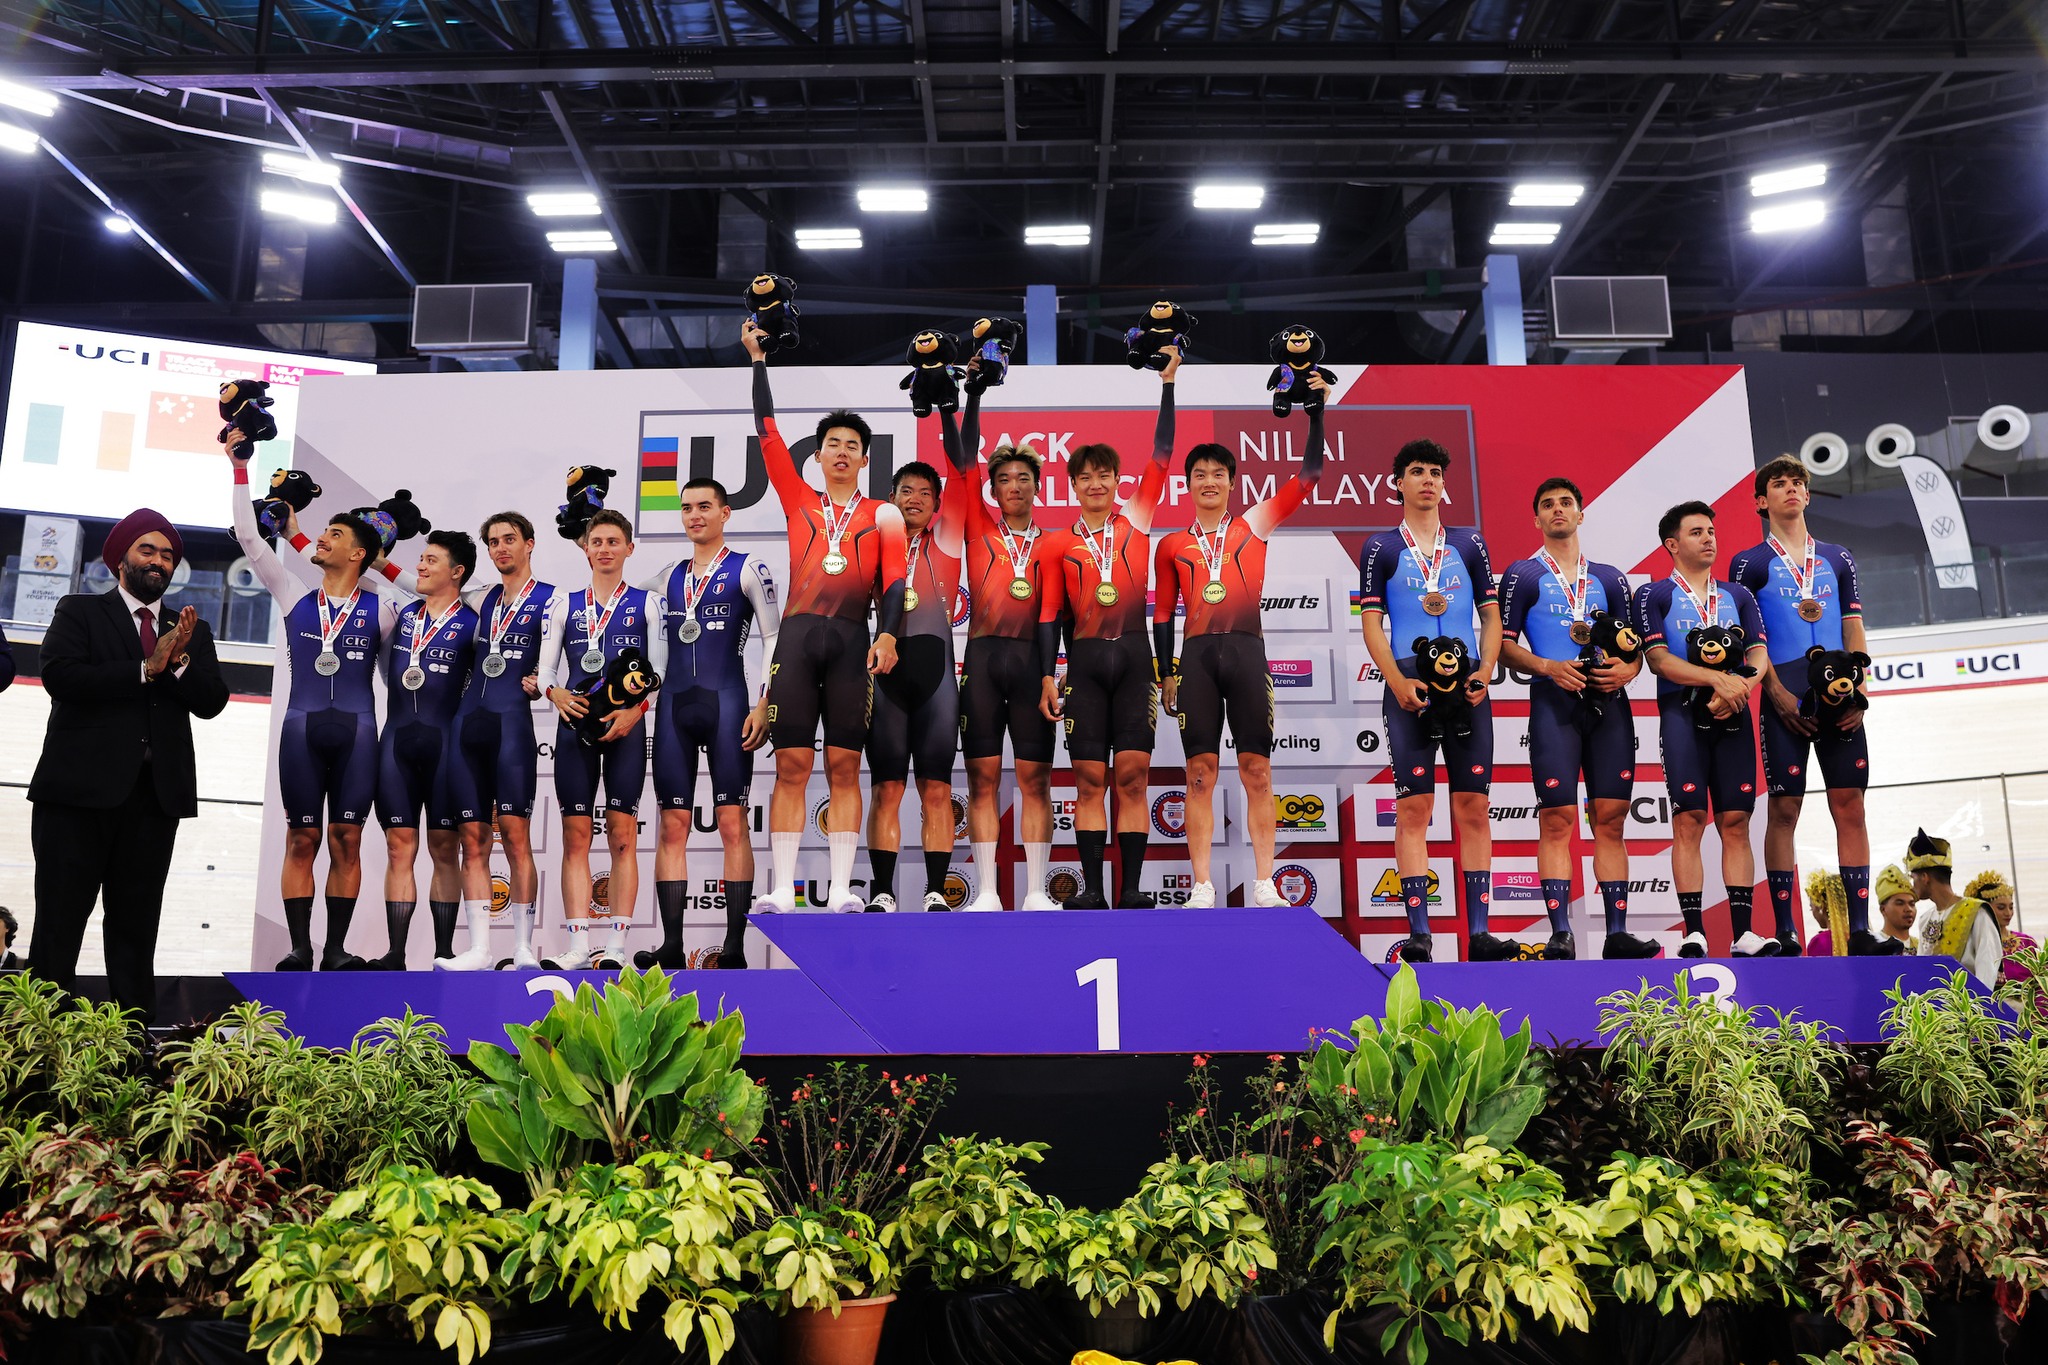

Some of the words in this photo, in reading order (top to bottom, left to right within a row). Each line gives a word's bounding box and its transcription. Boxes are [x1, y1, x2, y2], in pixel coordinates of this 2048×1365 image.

[75, 343, 150, 366] UCI
[939, 431, 1075, 463] RACK
[1241, 474, 1452, 505] MLAYSA
[1366, 541, 1382, 593] CASTELLI
[758, 563, 776, 600] CIC
[1406, 575, 1461, 589] ITAIA
[1779, 584, 1832, 598] ITAIA
[1259, 595, 1319, 612] sports
[1502, 573, 1520, 626] CASTELLI
[705, 605, 728, 616] CIC
[1549, 603, 1599, 615] ITAIA
[1640, 587, 1652, 633] CASTELLI
[1676, 619, 1734, 630] ITAIA
[345, 637, 368, 647] CIC
[503, 634, 529, 645] CIC
[615, 637, 638, 645] CIC
[430, 648, 454, 660] CIC
[1272, 662, 1298, 672] astro
[1967, 654, 2020, 673] UCI
[1874, 662, 1924, 682] UCI
[1760, 714, 1772, 780] CASTELLI
[1488, 806, 1539, 822] sport
[1630, 797, 1669, 824] CI
[693, 806, 763, 833] UI
[1507, 874, 1533, 884] astro
[494, 891, 507, 900] BS
[1143, 891, 1191, 905] TISS
[1509, 890, 1532, 898] Arena
[684, 896, 757, 909] TISST
[1075, 958, 1120, 1051] 1
